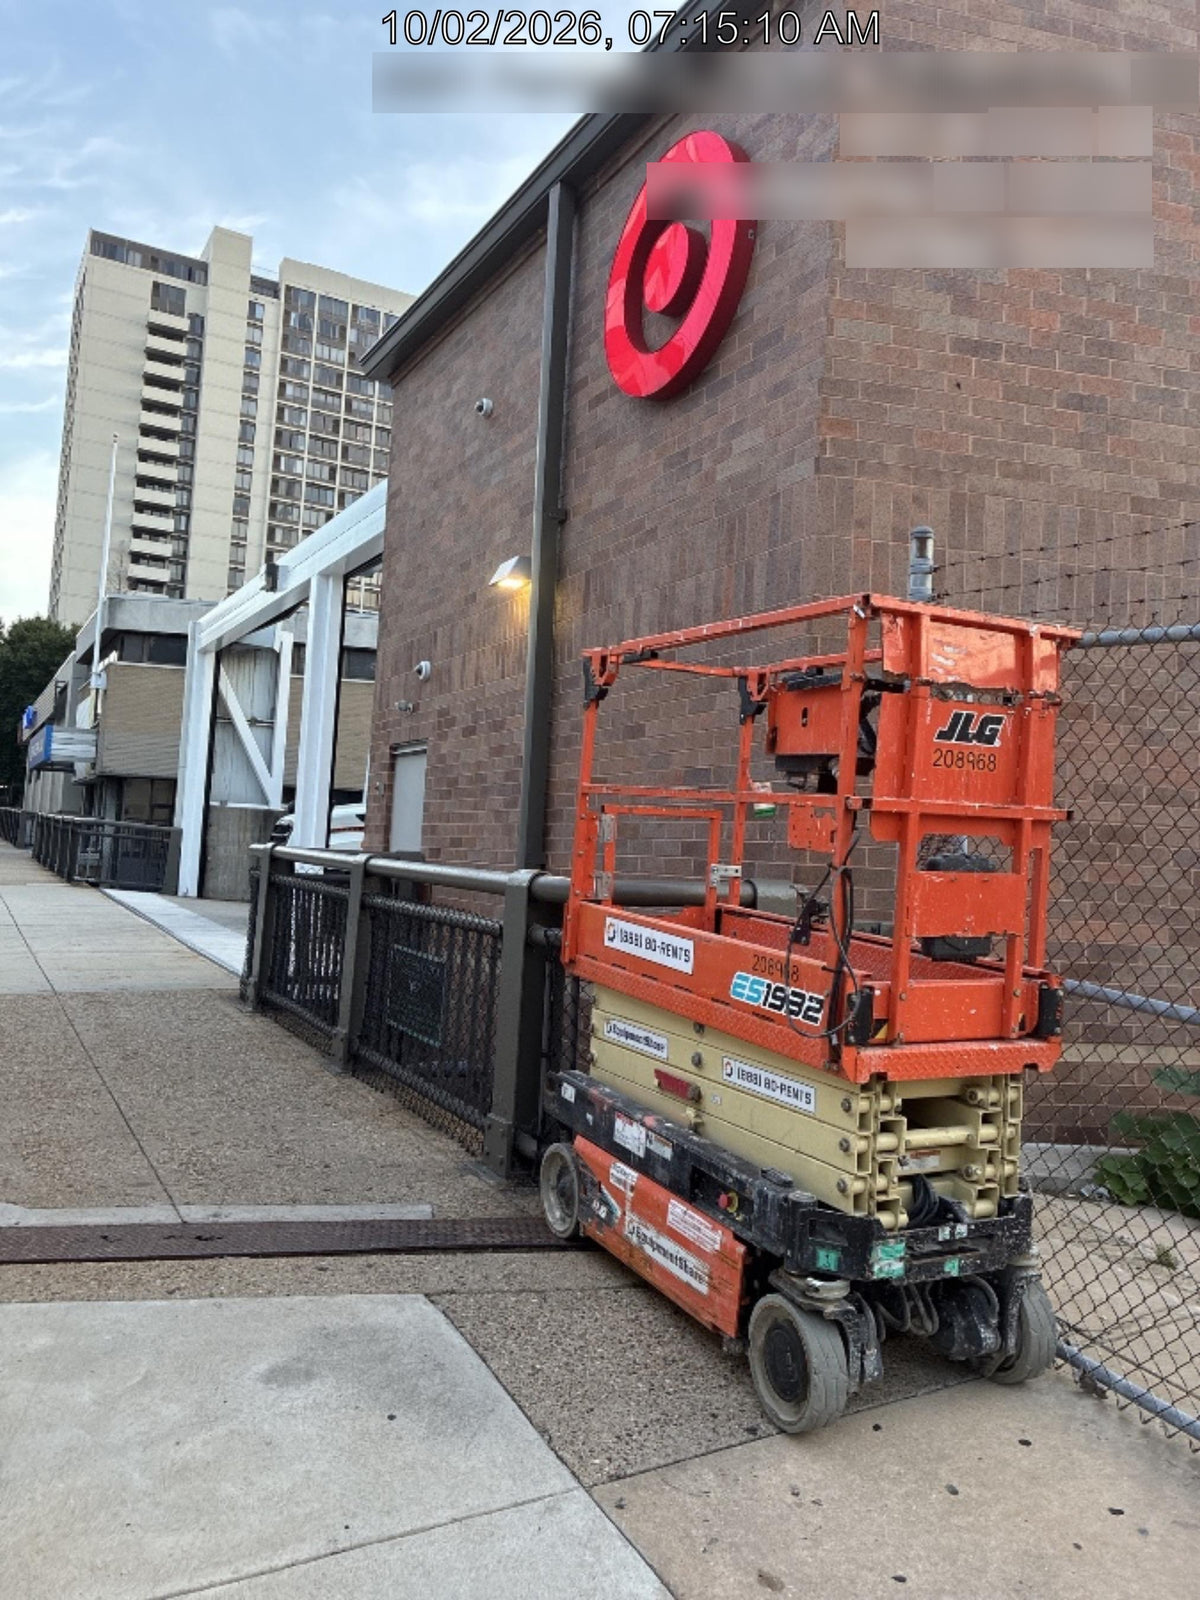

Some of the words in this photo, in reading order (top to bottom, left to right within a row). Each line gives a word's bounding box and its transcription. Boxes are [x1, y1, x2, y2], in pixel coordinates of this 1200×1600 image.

[934, 710, 1006, 746] JLG
[933, 749, 996, 772] 208968
[730, 971, 825, 1026] ES1932
